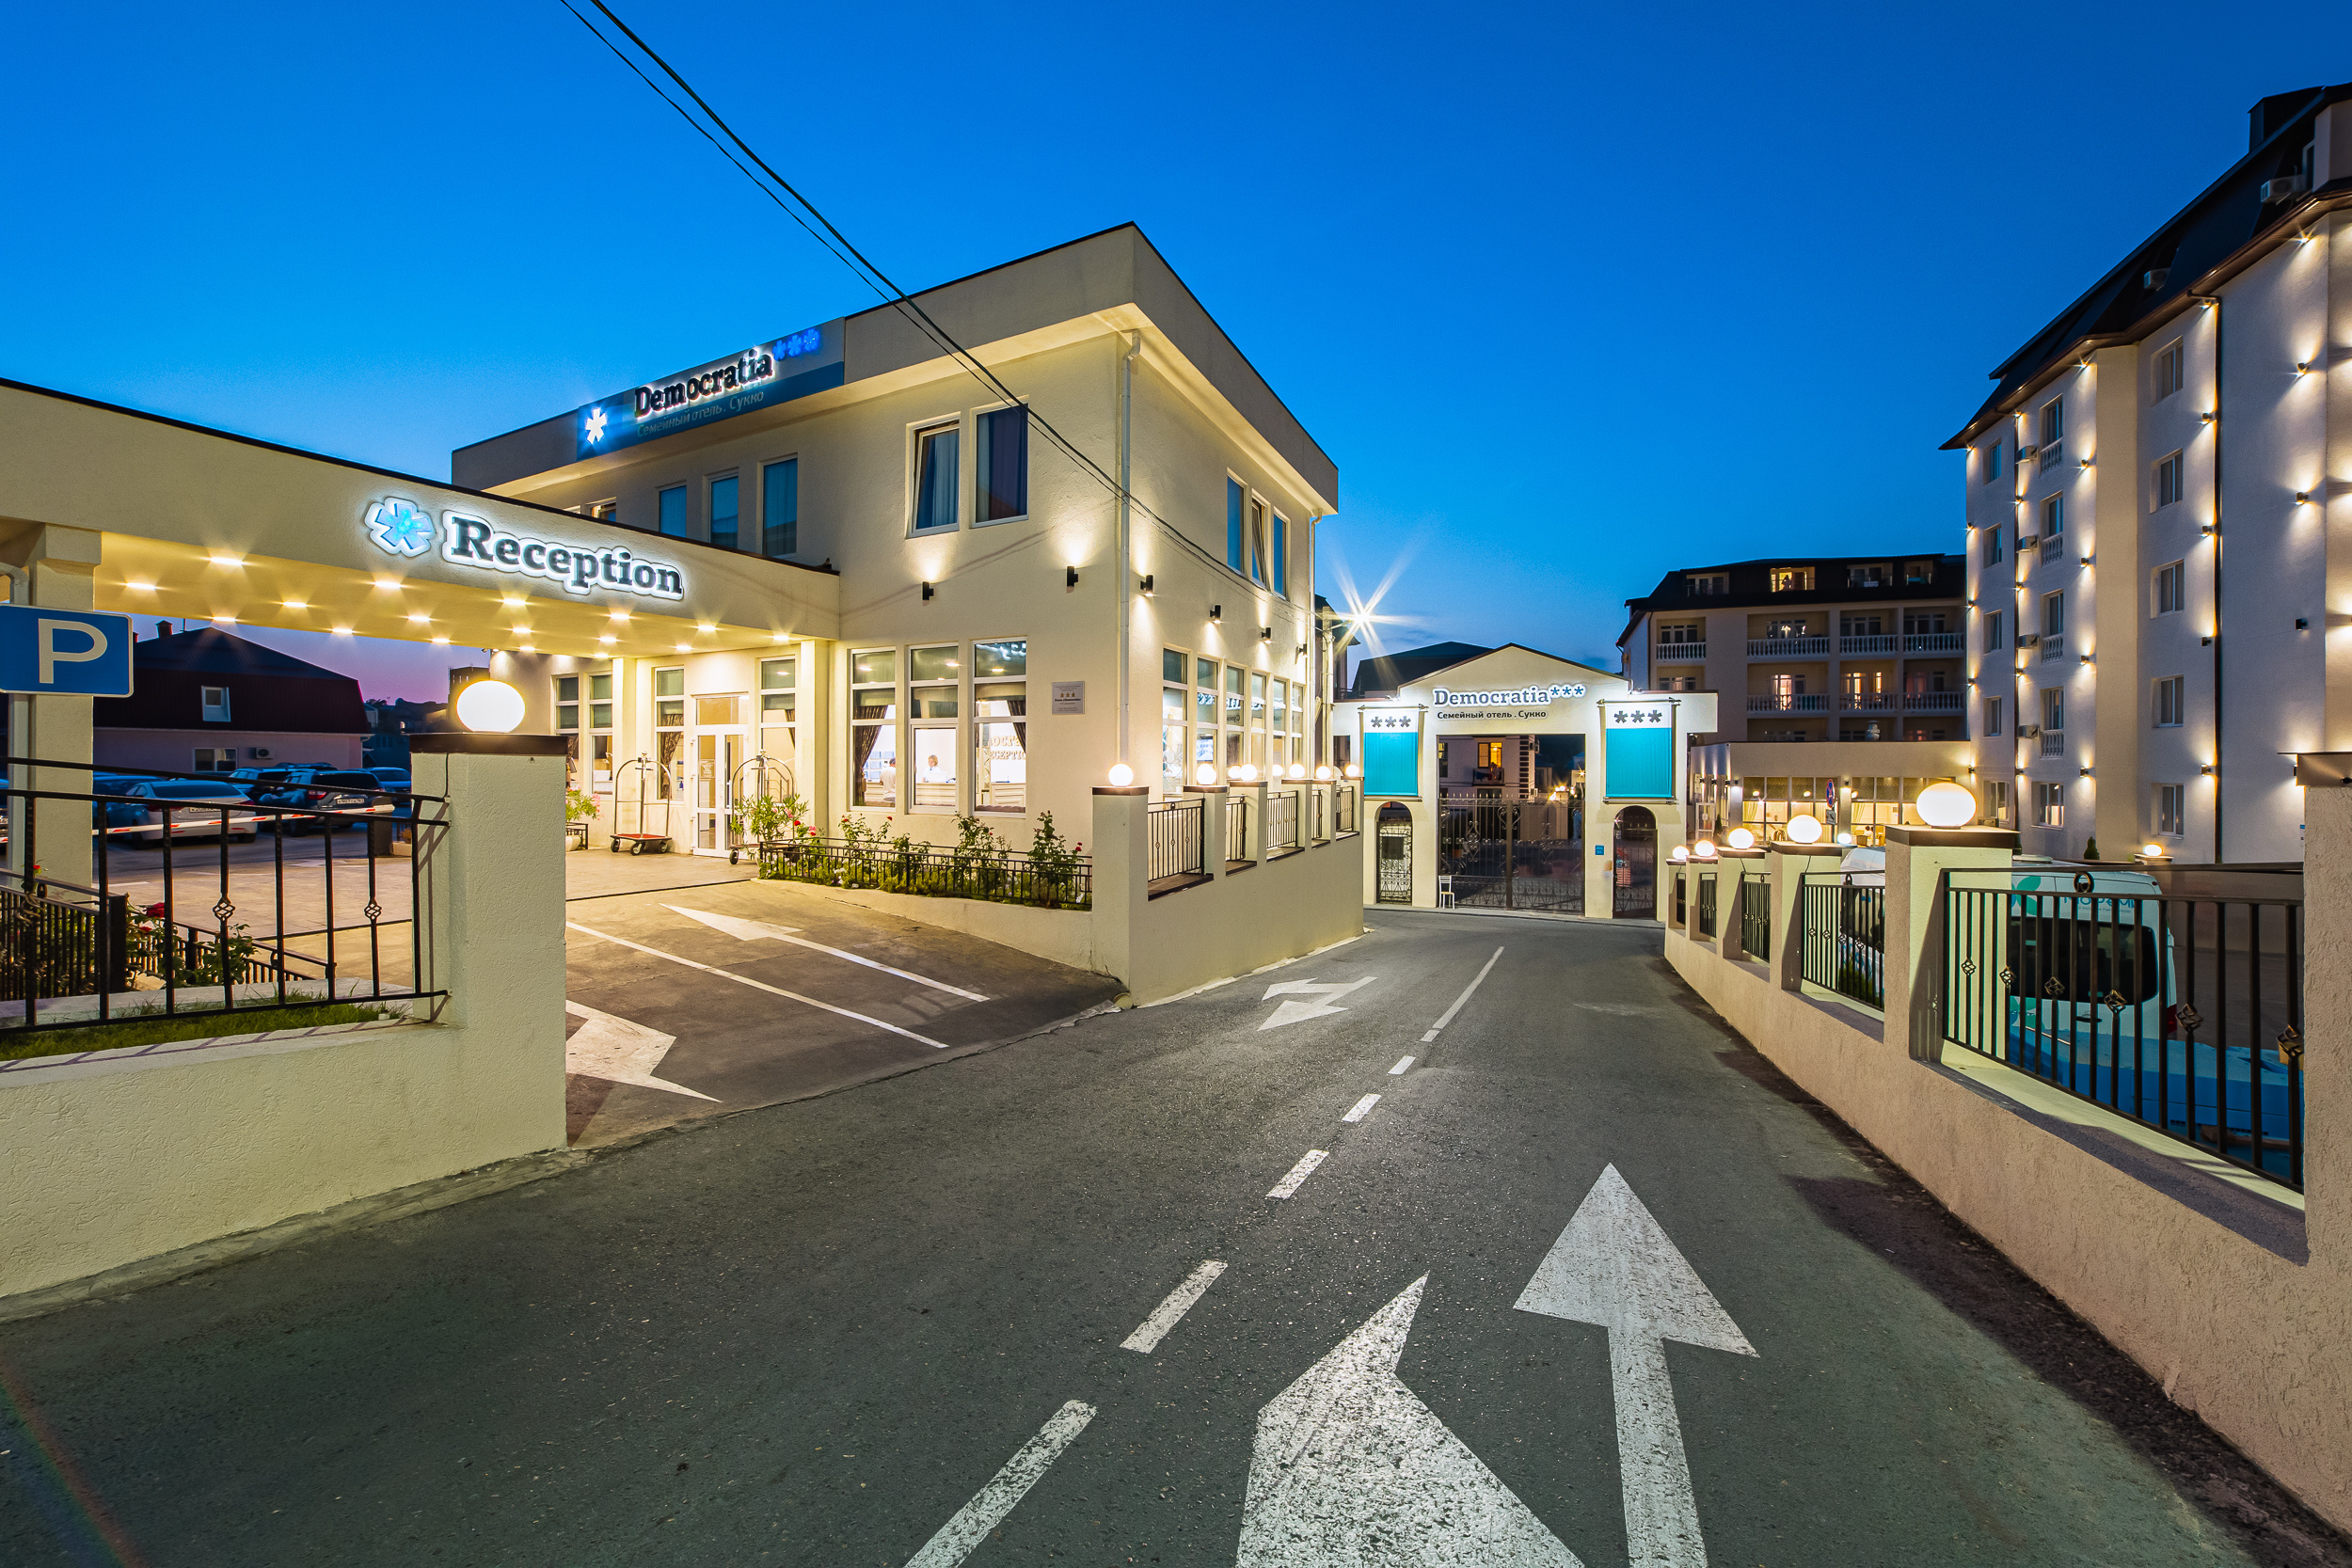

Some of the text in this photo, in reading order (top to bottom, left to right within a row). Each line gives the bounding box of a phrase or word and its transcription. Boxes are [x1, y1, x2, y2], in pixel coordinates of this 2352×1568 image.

[634, 348, 773, 419] Democratia
[638, 409, 690, 436] Семейный
[730, 391, 764, 412] Сукко
[452, 516, 682, 594] Reception
[39, 618, 107, 684] P
[1437, 711, 1484, 720] Семейный
[1518, 710, 1547, 720] Сукко
